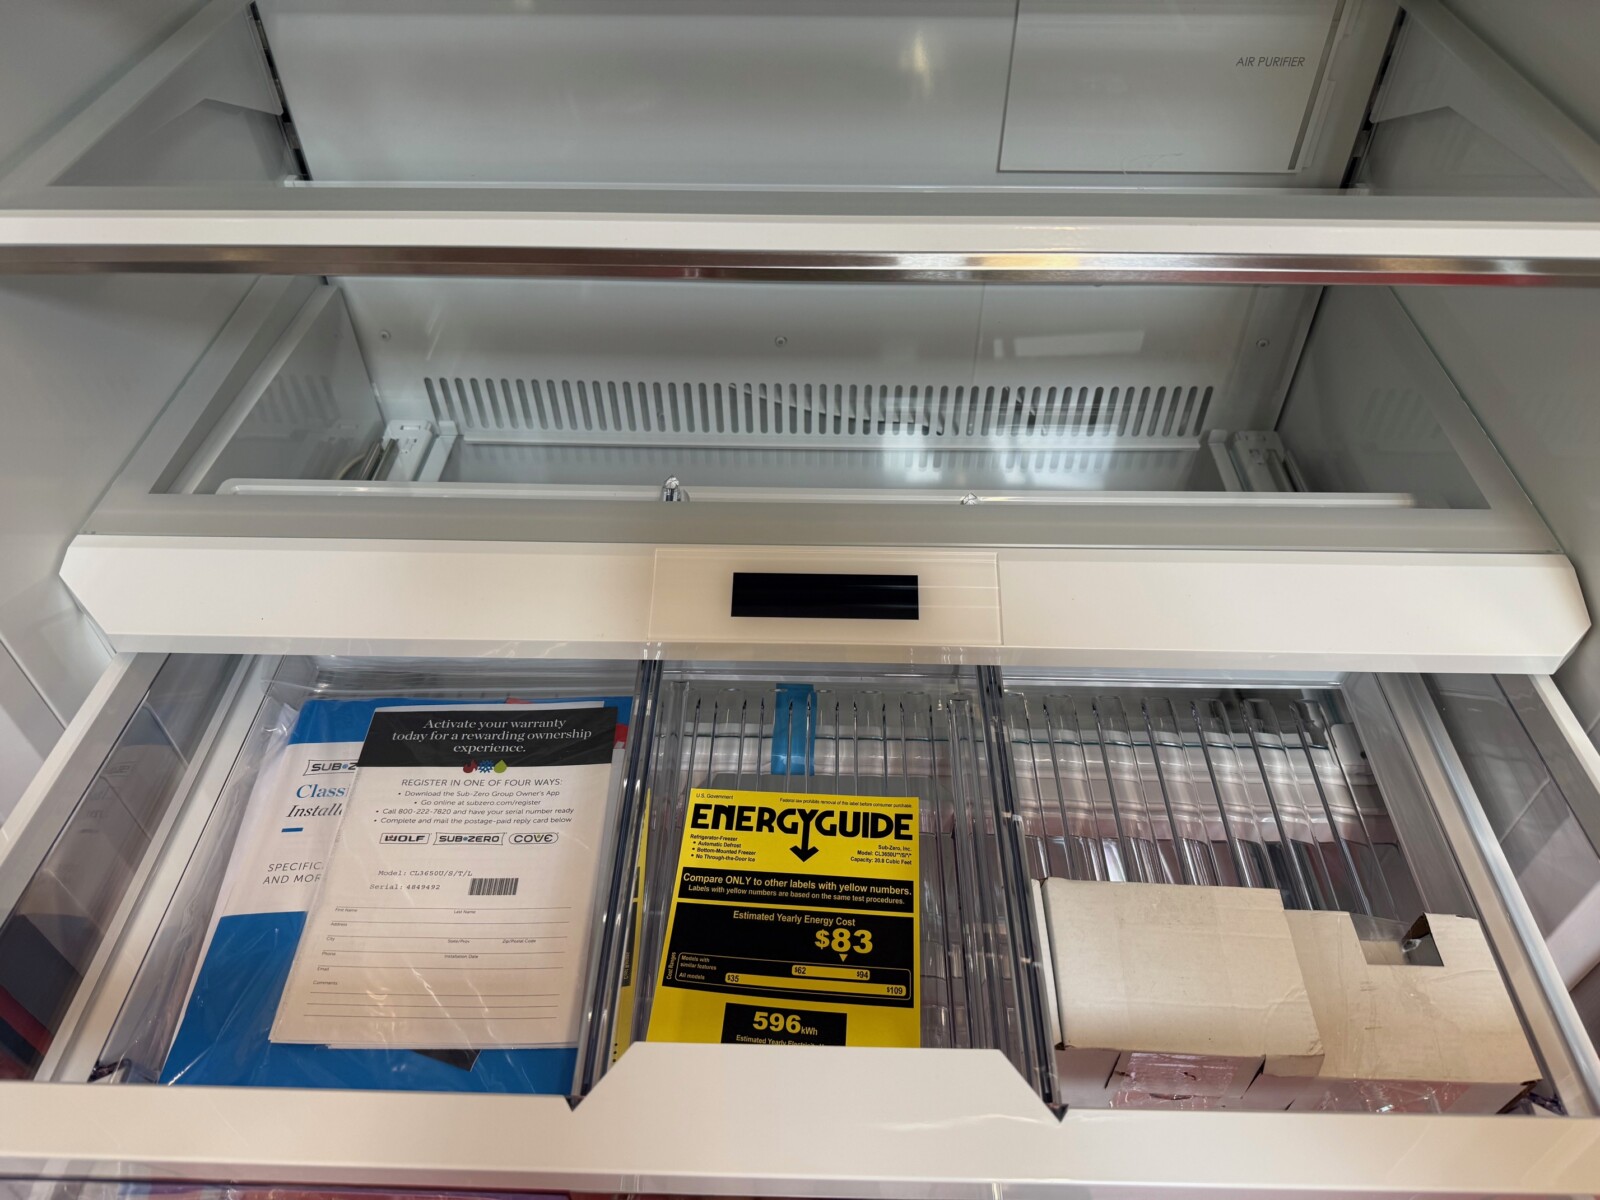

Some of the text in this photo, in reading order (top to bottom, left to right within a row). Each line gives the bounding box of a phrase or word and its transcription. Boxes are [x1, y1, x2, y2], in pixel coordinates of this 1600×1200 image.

[1235, 56, 1306, 67] AIR PURIFIER
[422, 719, 567, 731] Activate your warranty
[392, 731, 428, 742] today
[430, 731, 450, 741] for
[461, 731, 526, 743] rewarding
[527, 729, 592, 740] ownership
[453, 743, 526, 754] experience.
[401, 779, 447, 787] REGISTER
[463, 779, 485, 787] ONE
[488, 779, 502, 787] OF
[504, 779, 531, 787] FOUR
[534, 778, 562, 786] WAYS:
[466, 799, 541, 807] subzero.com/register
[554, 807, 575, 815] ready
[690, 803, 913, 841] ENERGYGUIDE
[384, 834, 425, 842] WOLF
[513, 834, 553, 843] COVE
[690, 833, 738, 841] Refrigerator-Freezer
[697, 847, 737, 855] Bottom-Mounted
[704, 854, 747, 862] Through-the-Door
[850, 856, 874, 864] Capacity:
[263, 875, 289, 885] AND
[683, 872, 912, 896] Compare ONLY to other labels with yellow numbers.
[688, 884, 710, 892] Labels
[726, 886, 748, 895] yellow
[748, 888, 777, 897] numbers
[790, 890, 810, 898] based
[821, 892, 832, 900] the
[866, 896, 905, 905] procedures.
[733, 910, 856, 927] Estimated Yearly Energy Cost
[814, 927, 873, 954] $83
[668, 951, 677, 969] Ranges
[697, 963, 717, 971] features
[794, 966, 807, 975] $62
[727, 974, 740, 983] $35
[856, 970, 869, 979] $94
[886, 986, 903, 995] $109
[752, 1011, 818, 1036] 596 kWh
[736, 1034, 767, 1044] Estimated
